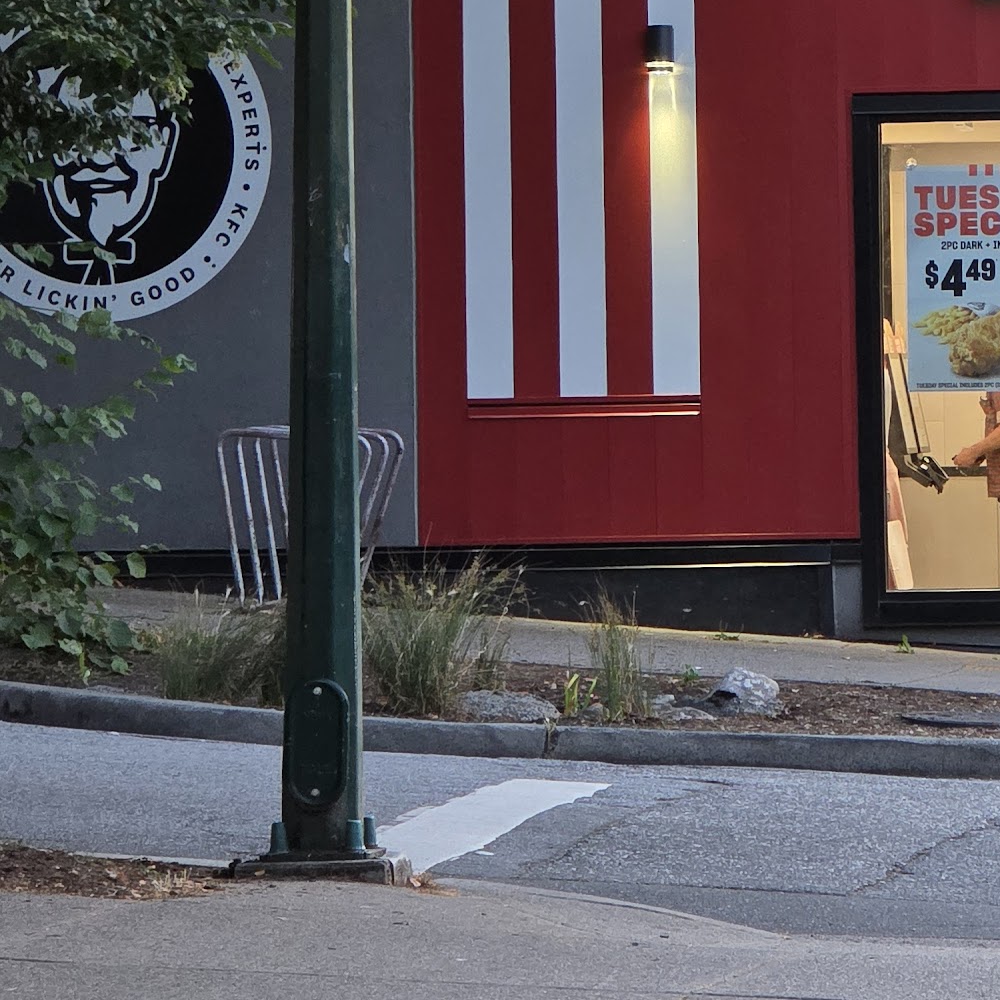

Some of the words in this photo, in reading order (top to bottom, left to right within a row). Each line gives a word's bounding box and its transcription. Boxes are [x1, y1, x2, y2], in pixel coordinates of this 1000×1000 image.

[215, 203, 248, 247] KFC
[941, 241, 958, 250] 2PC
[960, 240, 983, 250] DARK
[23, 279, 117, 310] LICKIN'
[130, 267, 195, 306] GOOD
